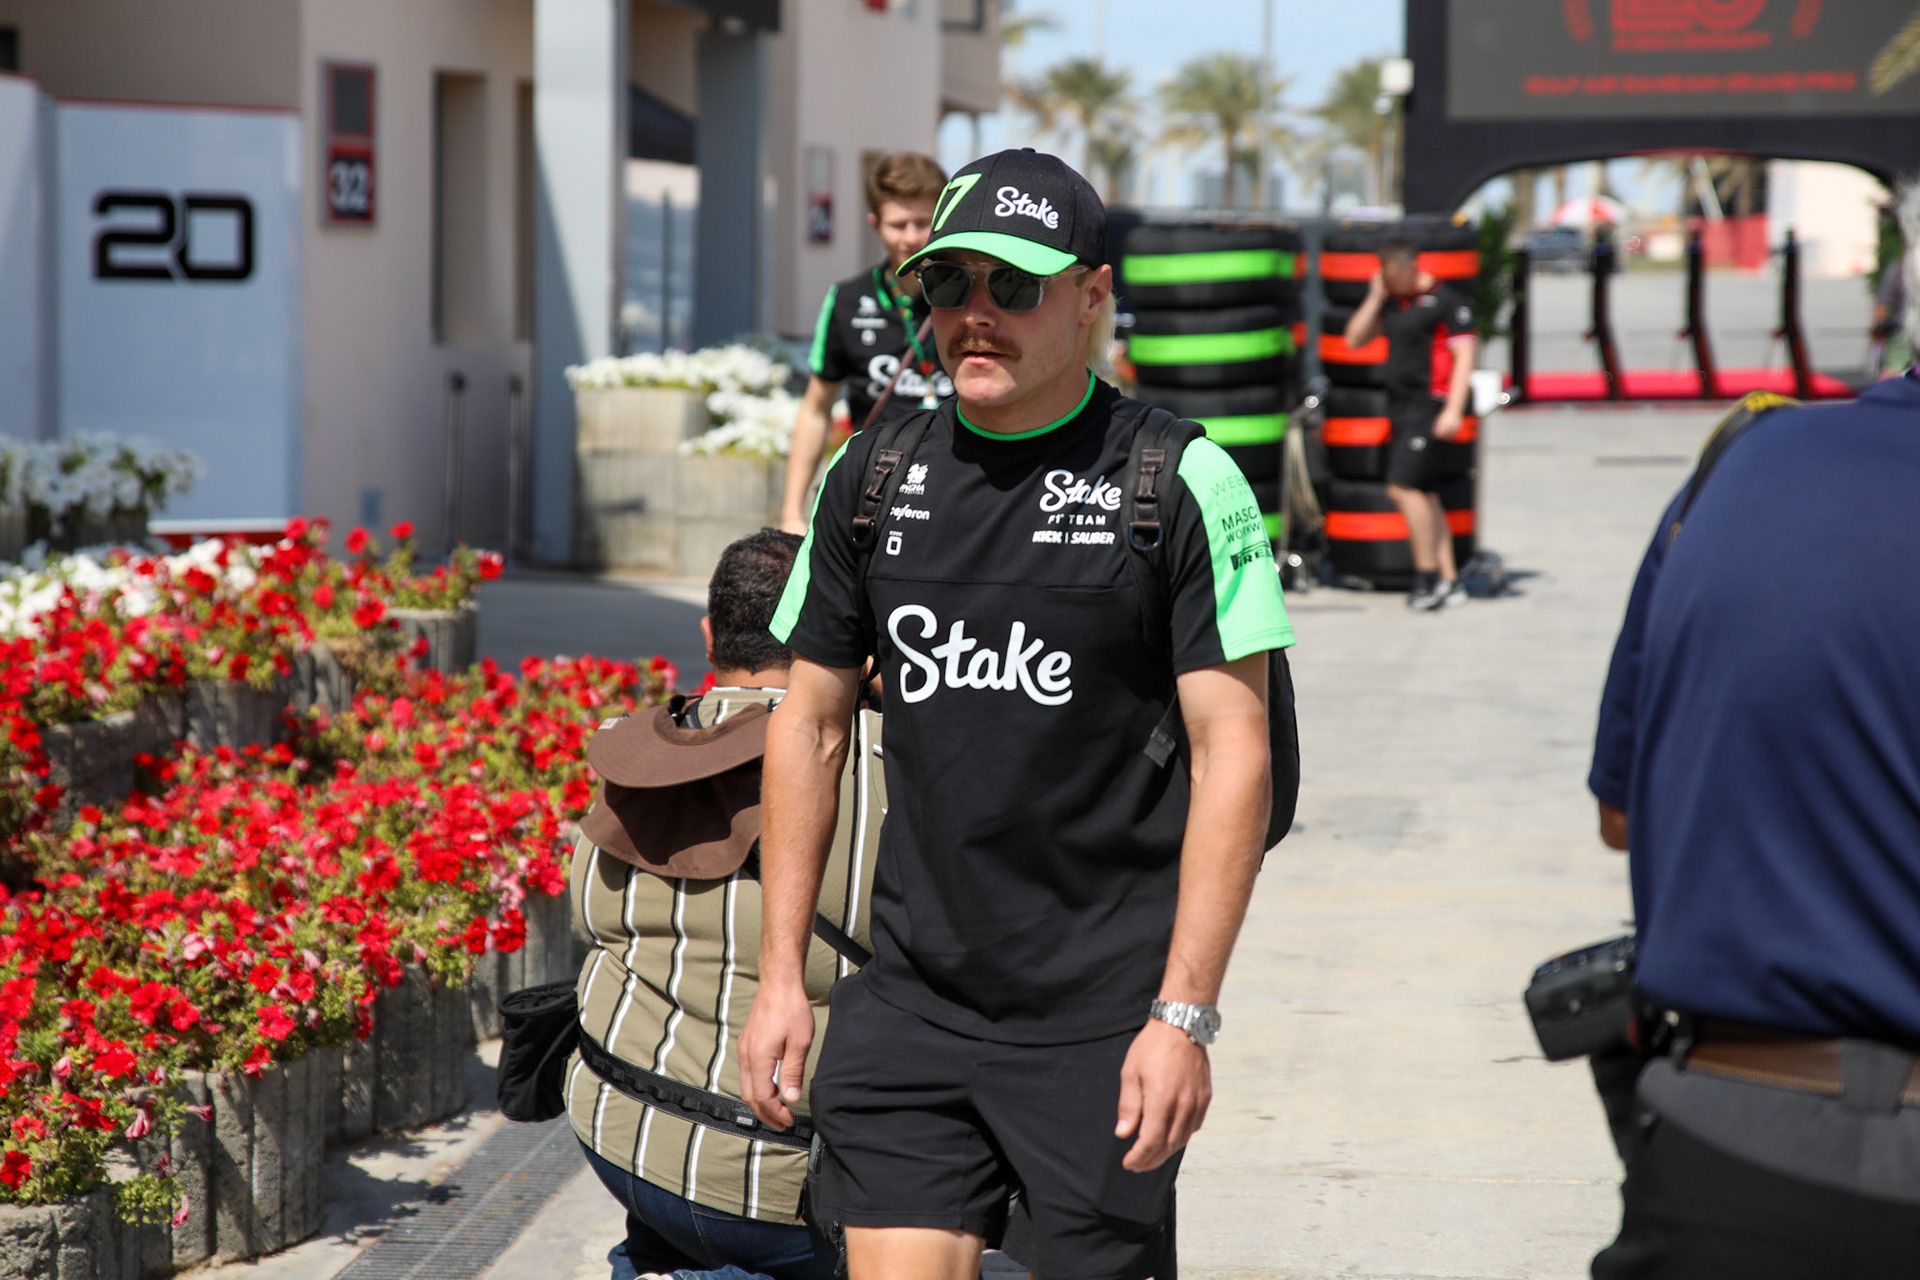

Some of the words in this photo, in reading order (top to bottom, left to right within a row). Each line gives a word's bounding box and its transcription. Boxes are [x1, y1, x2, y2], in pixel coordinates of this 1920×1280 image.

[331, 163, 371, 210] 32
[995, 186, 1059, 229] Stake
[93, 193, 254, 280] 20
[1039, 469, 1122, 512] Stake
[1032, 530, 1062, 544] KICK
[1070, 531, 1116, 545] SAUBER
[1068, 514, 1106, 526] TEAM
[1221, 505, 1259, 532] MASC
[1226, 521, 1261, 544] WORKW
[887, 604, 1073, 706] Stake
